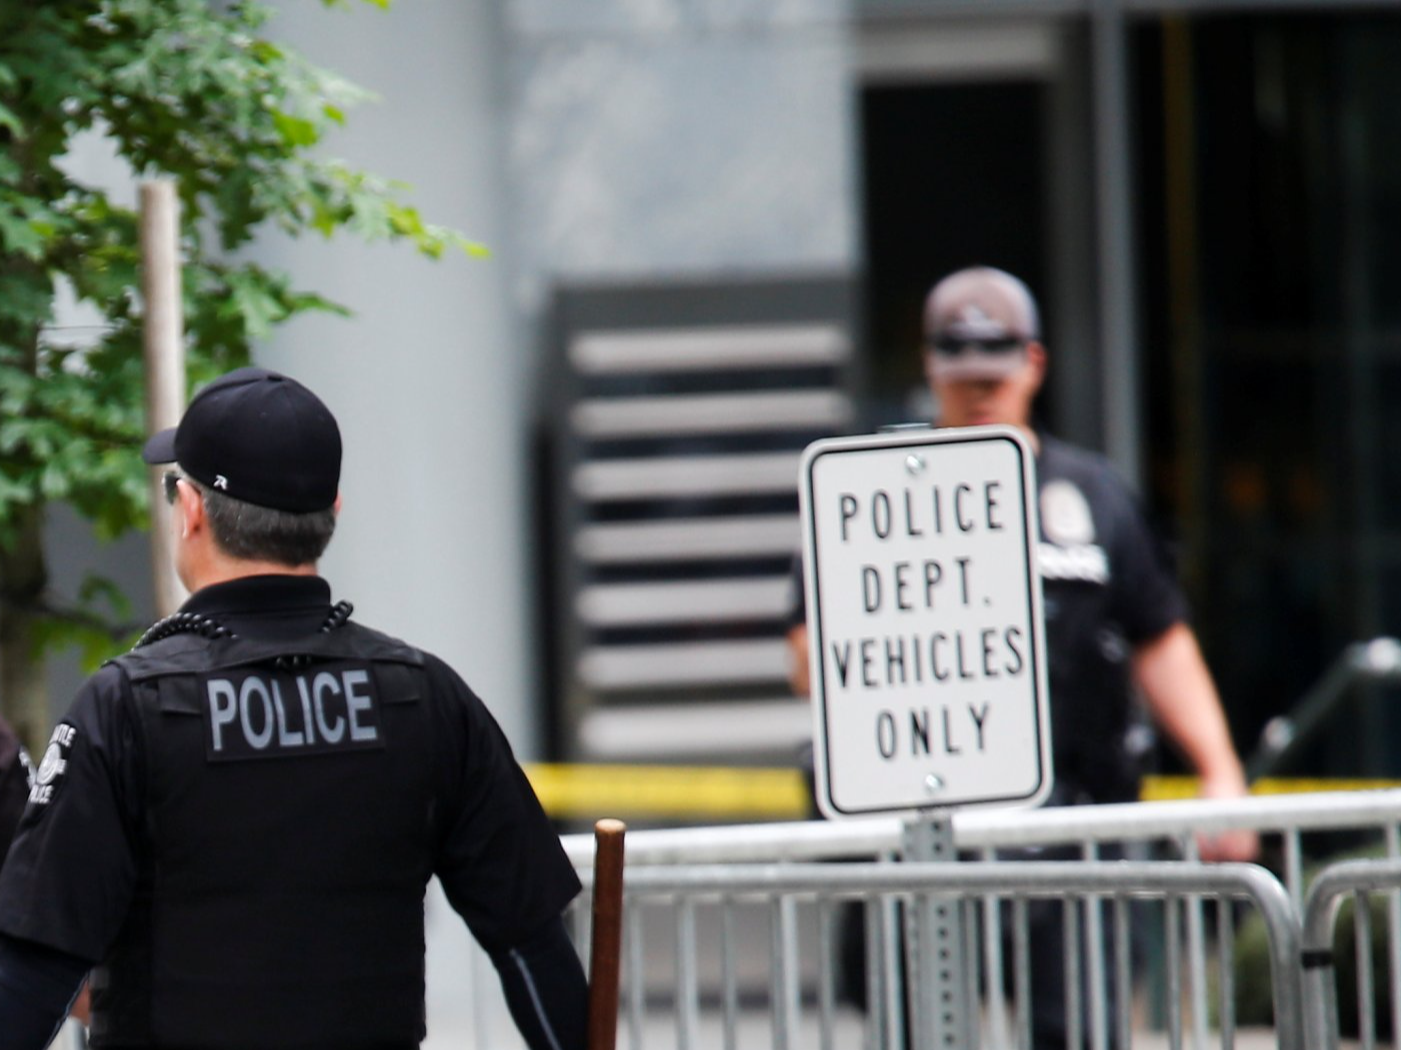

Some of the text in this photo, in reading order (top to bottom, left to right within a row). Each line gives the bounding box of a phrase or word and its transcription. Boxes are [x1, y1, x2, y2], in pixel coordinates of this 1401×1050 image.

[839, 481, 1006, 541] POLICE
[861, 557, 991, 614] DEPT.
[832, 626, 1024, 689] VEHICLES
[206, 669, 378, 751] POLICE
[876, 704, 990, 760] ONLY
